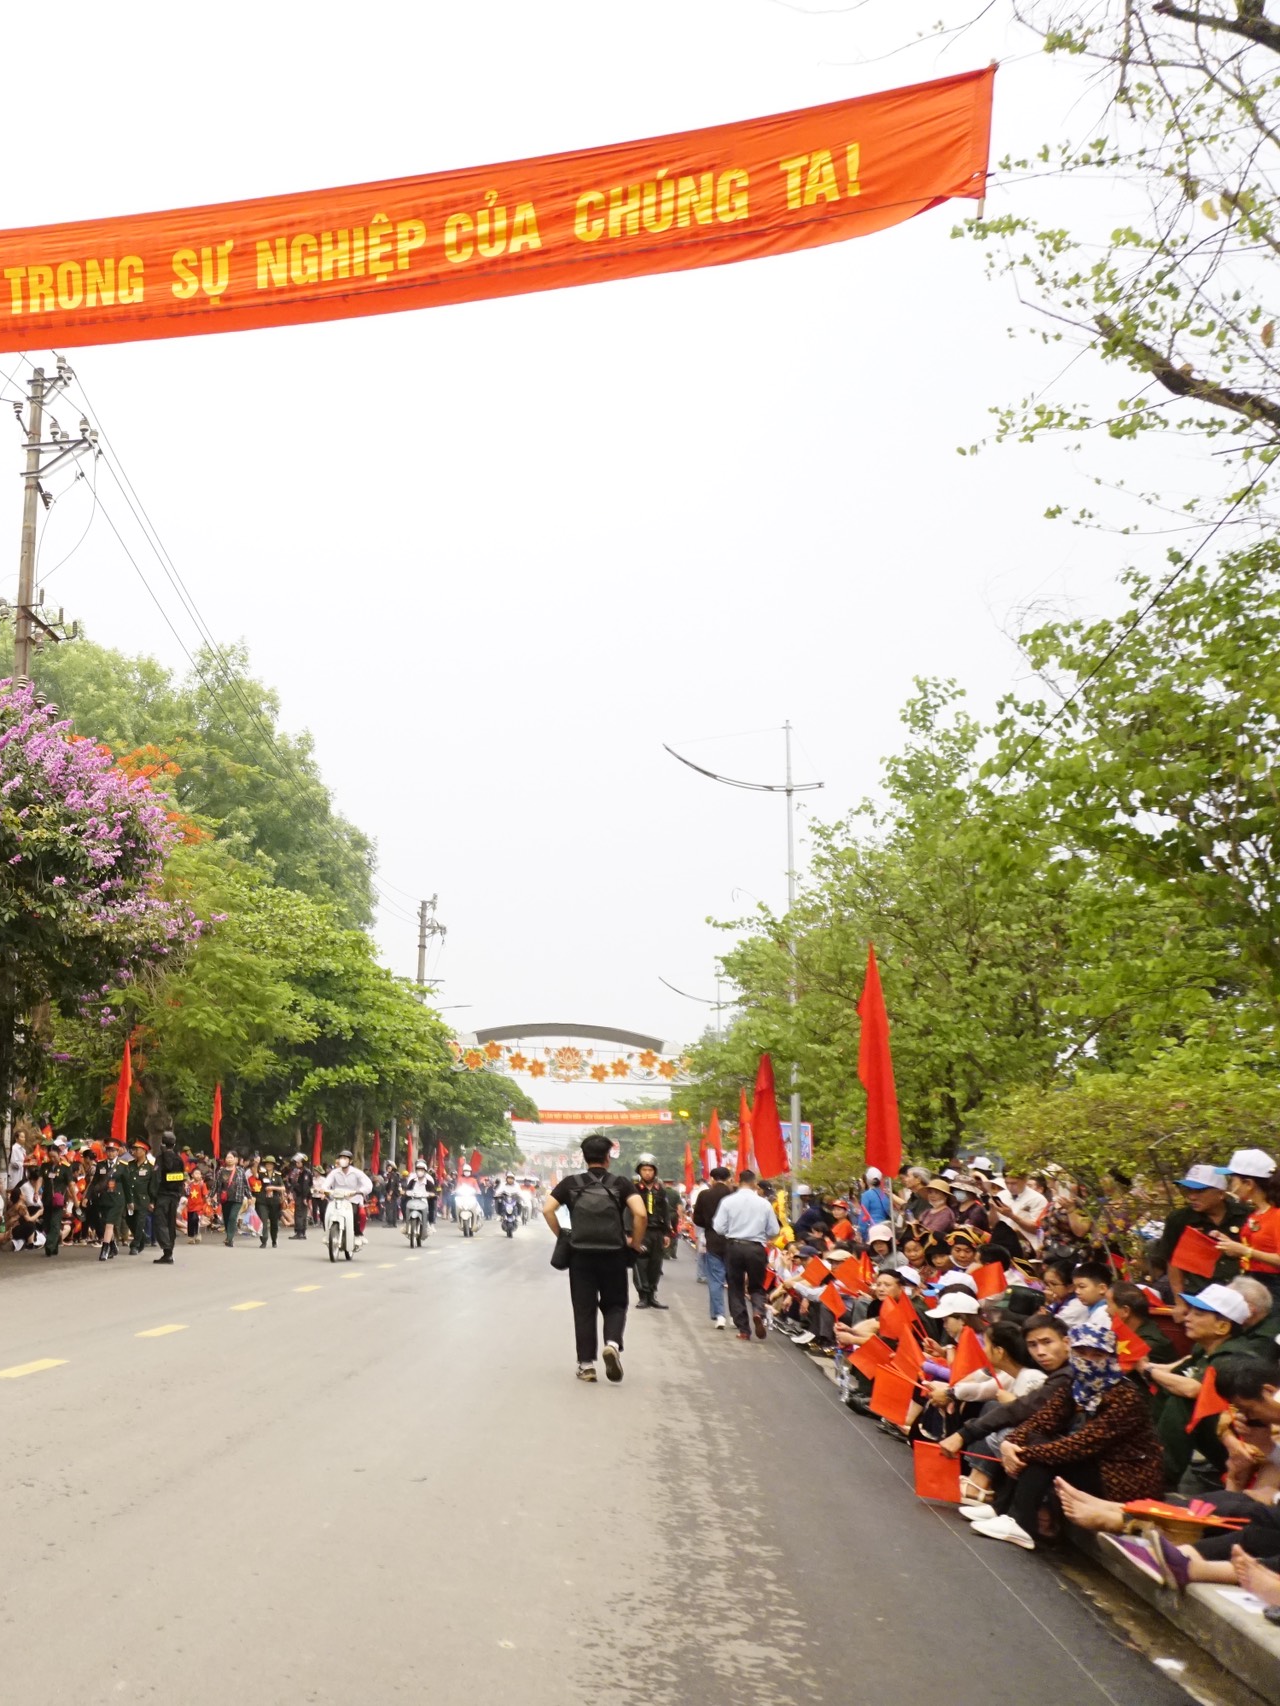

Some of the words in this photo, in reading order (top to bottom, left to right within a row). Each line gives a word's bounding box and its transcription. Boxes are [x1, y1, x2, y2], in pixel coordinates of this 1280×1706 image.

[4, 255, 144, 314] TRONG
[171, 239, 233, 304] SỰ
[257, 213, 427, 290] NGHIỆP
[444, 190, 542, 264] CỦA
[573, 168, 749, 242] CHÚNG
